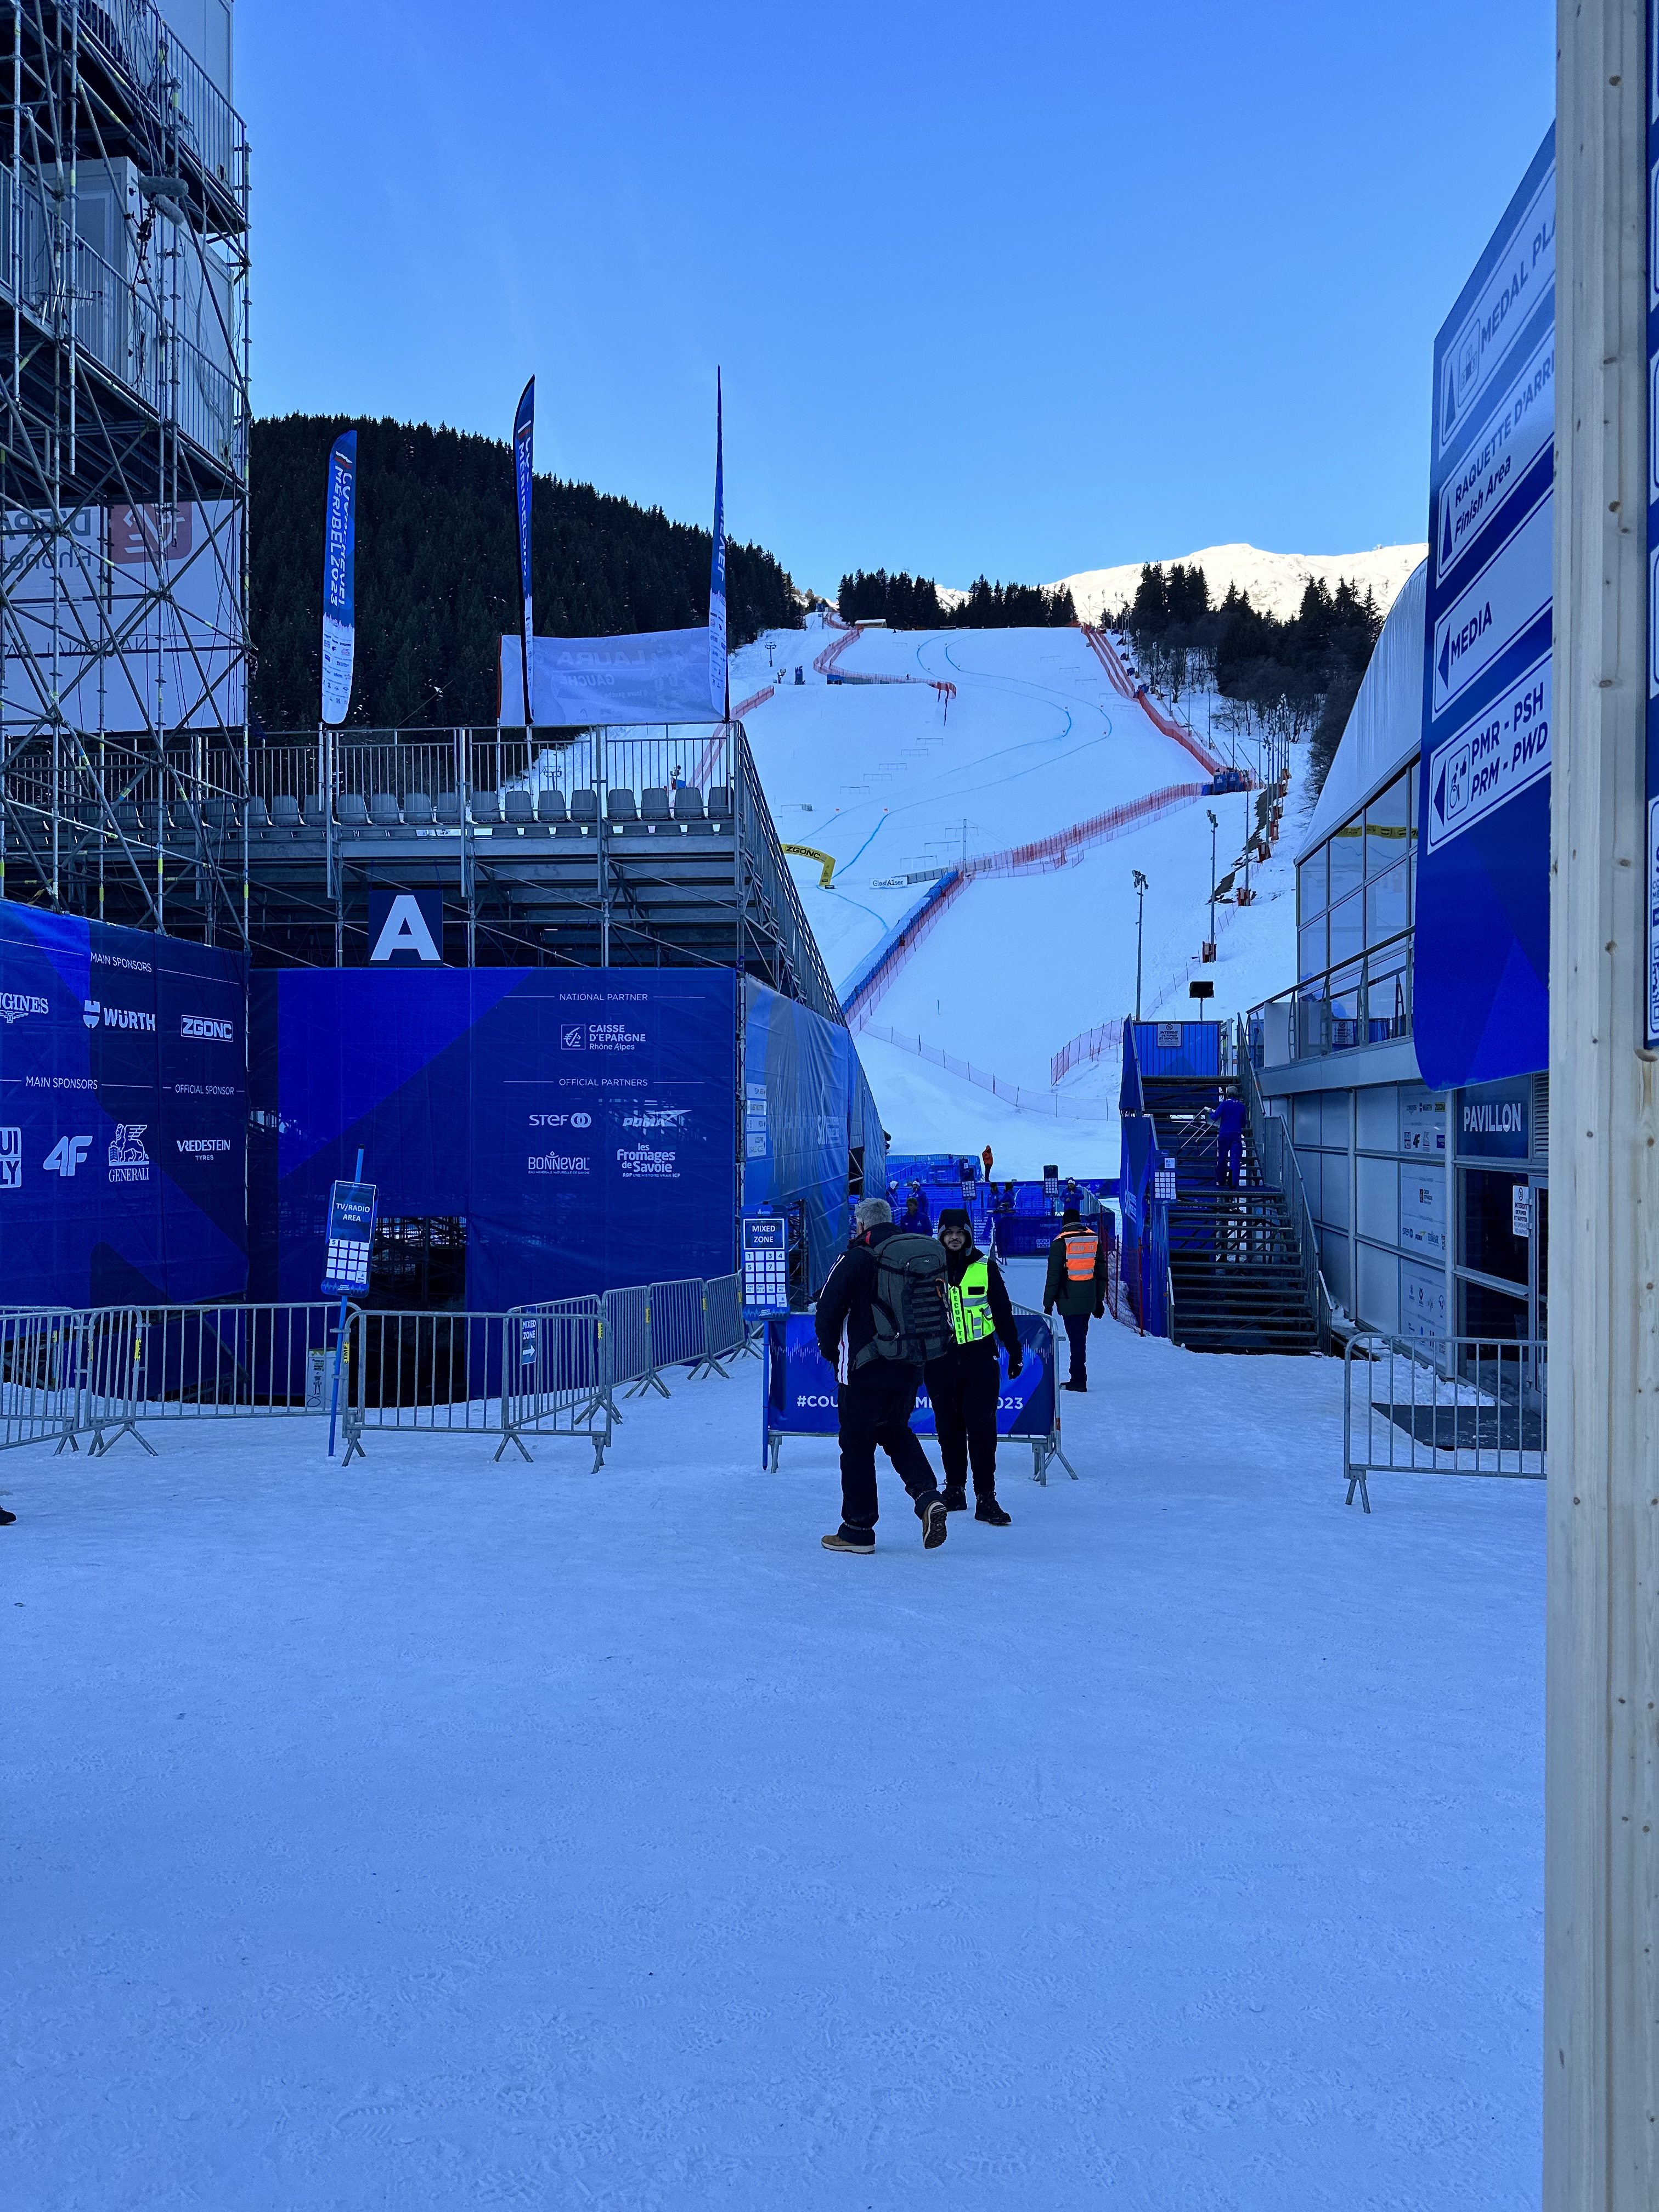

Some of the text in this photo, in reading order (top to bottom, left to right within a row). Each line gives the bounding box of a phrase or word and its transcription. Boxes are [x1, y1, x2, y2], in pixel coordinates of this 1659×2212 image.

[1481, 261, 1528, 355] MEDAL
[1455, 413, 1511, 508] RAQUETTE
[1454, 455, 1511, 543] Finish Area
[1451, 602, 1492, 665] MEDIA
[1472, 720, 1500, 766] PMR
[1514, 681, 1544, 732] PSH
[1471, 757, 1500, 802] PRM
[1512, 721, 1548, 773] PWD
[786, 846, 821, 860] ZGONC
[370, 895, 441, 961] A
[91, 952, 152, 973] MAIN SPONSORS
[0, 992, 49, 1014] GINES
[183, 1018, 232, 1039] ZGONC
[590, 1034, 646, 1042] D'EPARGNE
[614, 1042, 635, 1051] Alpes
[26, 1076, 98, 1090] MAIN SPONSORS
[175, 1084, 234, 1095] OFFICIAL SPONSOR
[1463, 1103, 1521, 1132] PAVILLON
[177, 1139, 230, 1152] VREDESTEIN
[43, 1136, 93, 1177] 4F
[617, 1149, 675, 1164] Fromages
[622, 1160, 673, 1172] de Savoie
[109, 1167, 149, 1182] GENERALI
[336, 1203, 370, 1213] TV/RADIO
[342, 1214, 361, 1222] AREA
[522, 1319, 537, 1329] MIXED
[523, 1330, 535, 1340] ZONE
